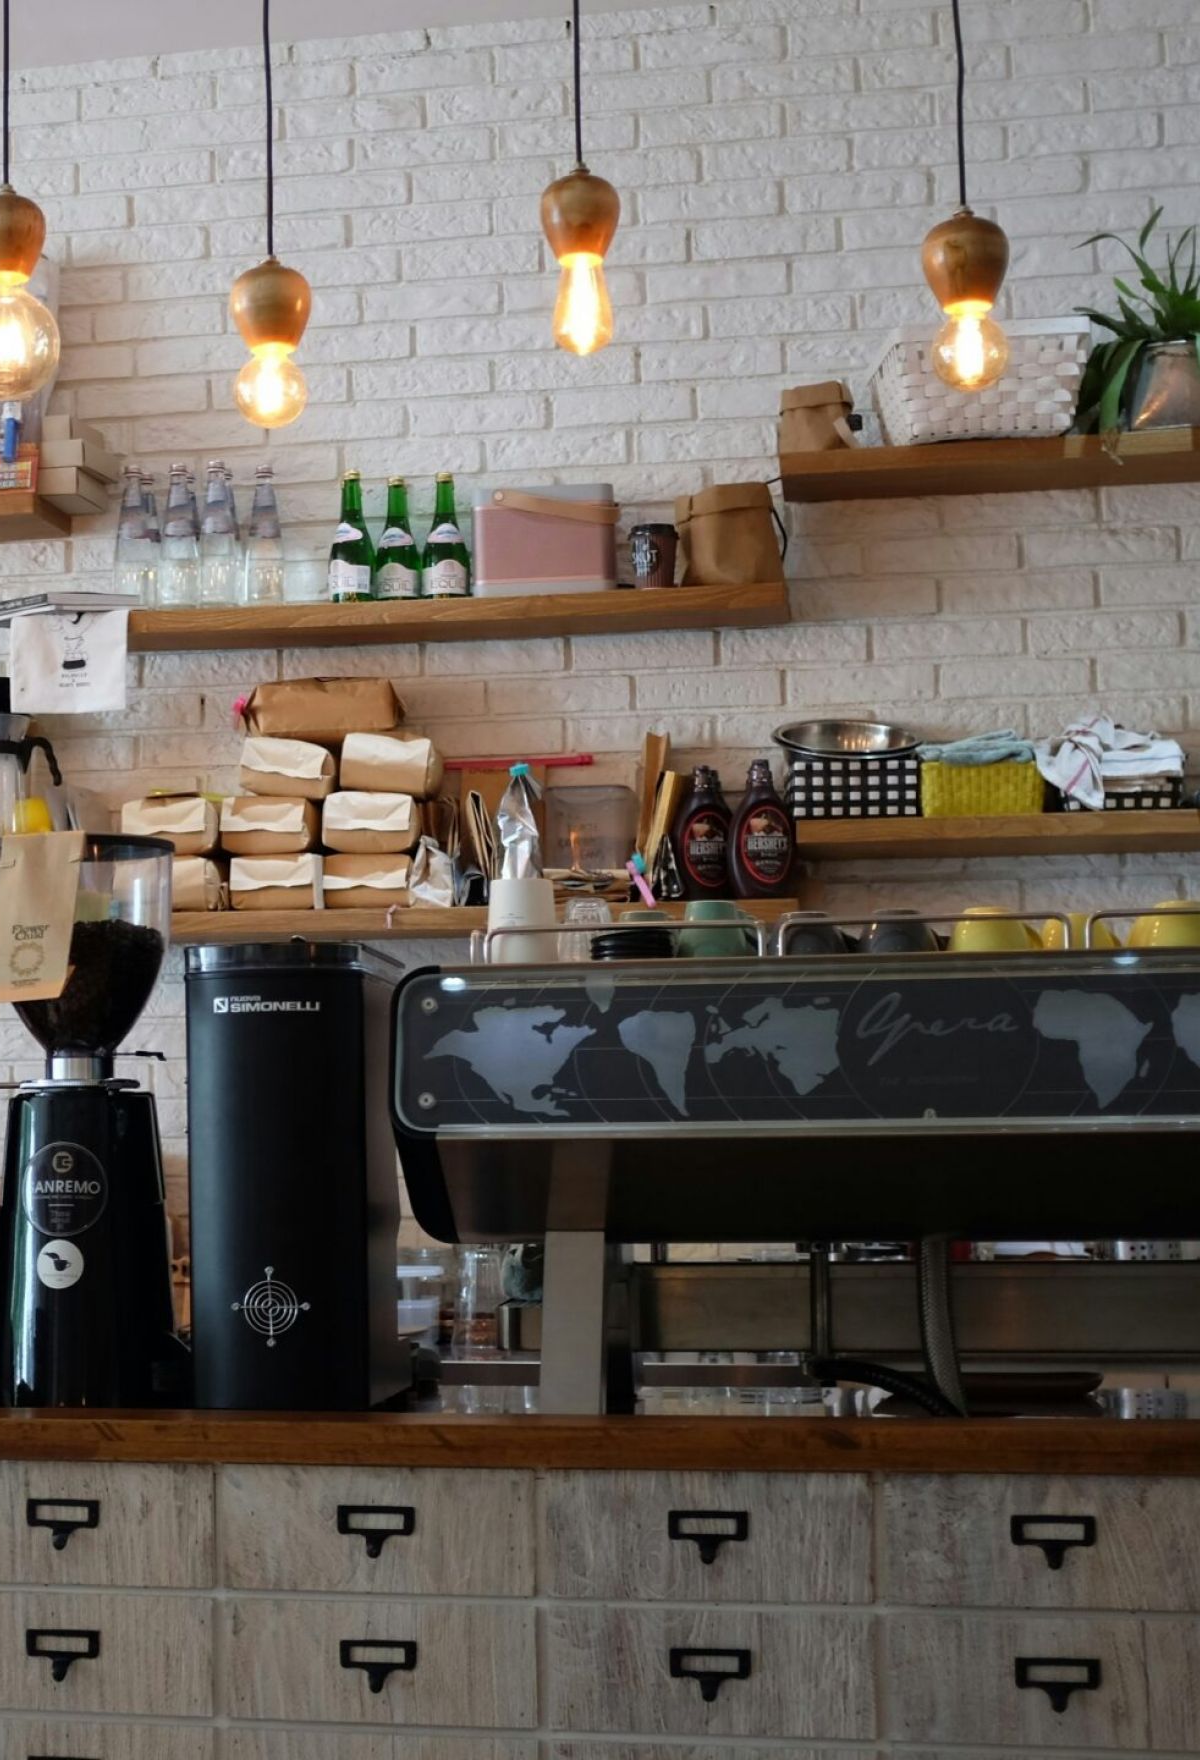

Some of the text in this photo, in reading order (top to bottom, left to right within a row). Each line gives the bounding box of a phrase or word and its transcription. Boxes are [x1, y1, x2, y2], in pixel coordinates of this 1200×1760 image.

[230, 1001, 319, 1012] SIMONELLI
[857, 991, 1019, 1066] Opera
[32, 1180, 101, 1195] ANREMO
